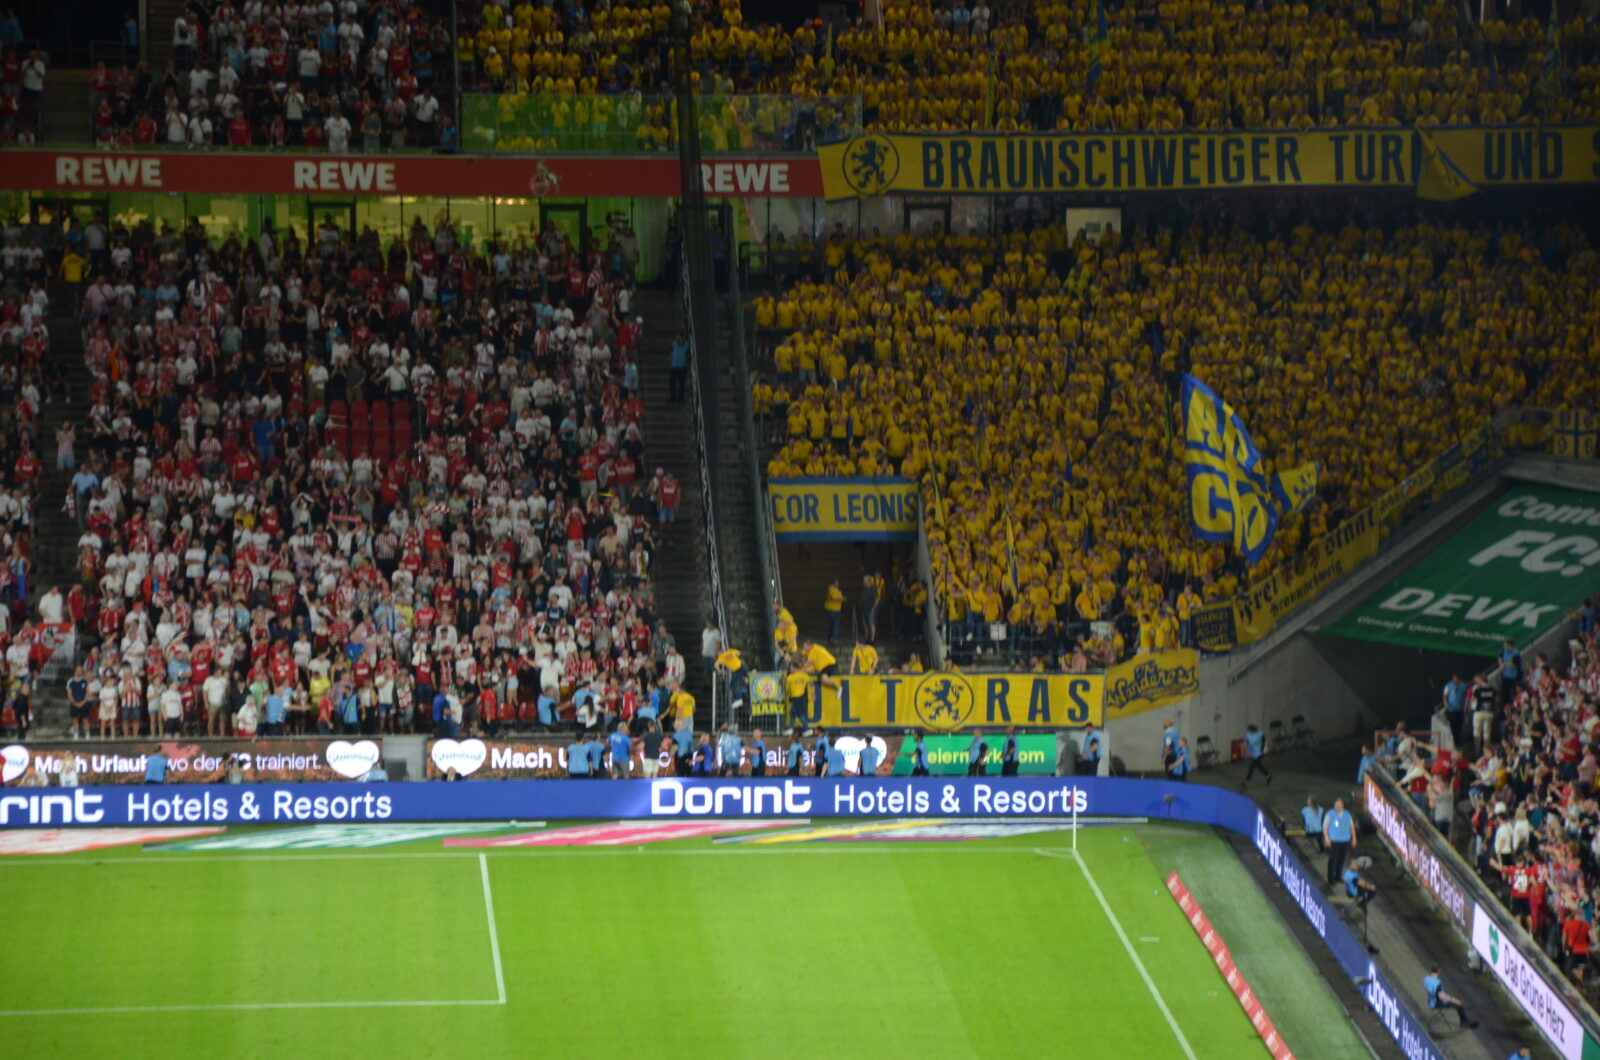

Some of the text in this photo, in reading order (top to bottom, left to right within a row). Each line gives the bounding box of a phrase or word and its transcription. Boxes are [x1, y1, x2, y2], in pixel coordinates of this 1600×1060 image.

[56, 156, 162, 186] REWE
[922, 137, 1302, 188] BRAUNSCHWEIGER
[1485, 131, 1562, 180] UND
[294, 160, 396, 191] REWE
[772, 492, 918, 523] COR LEONIS
[1379, 587, 1559, 628] DEVK
[34, 755, 87, 774] Mah
[193, 754, 222, 771] der
[491, 747, 552, 769] Mach
[127, 791, 229, 822] Hotels
[239, 791, 260, 820] &
[274, 790, 392, 820] Resorts
[651, 780, 1088, 814] Dorint Hotels & Resorts
